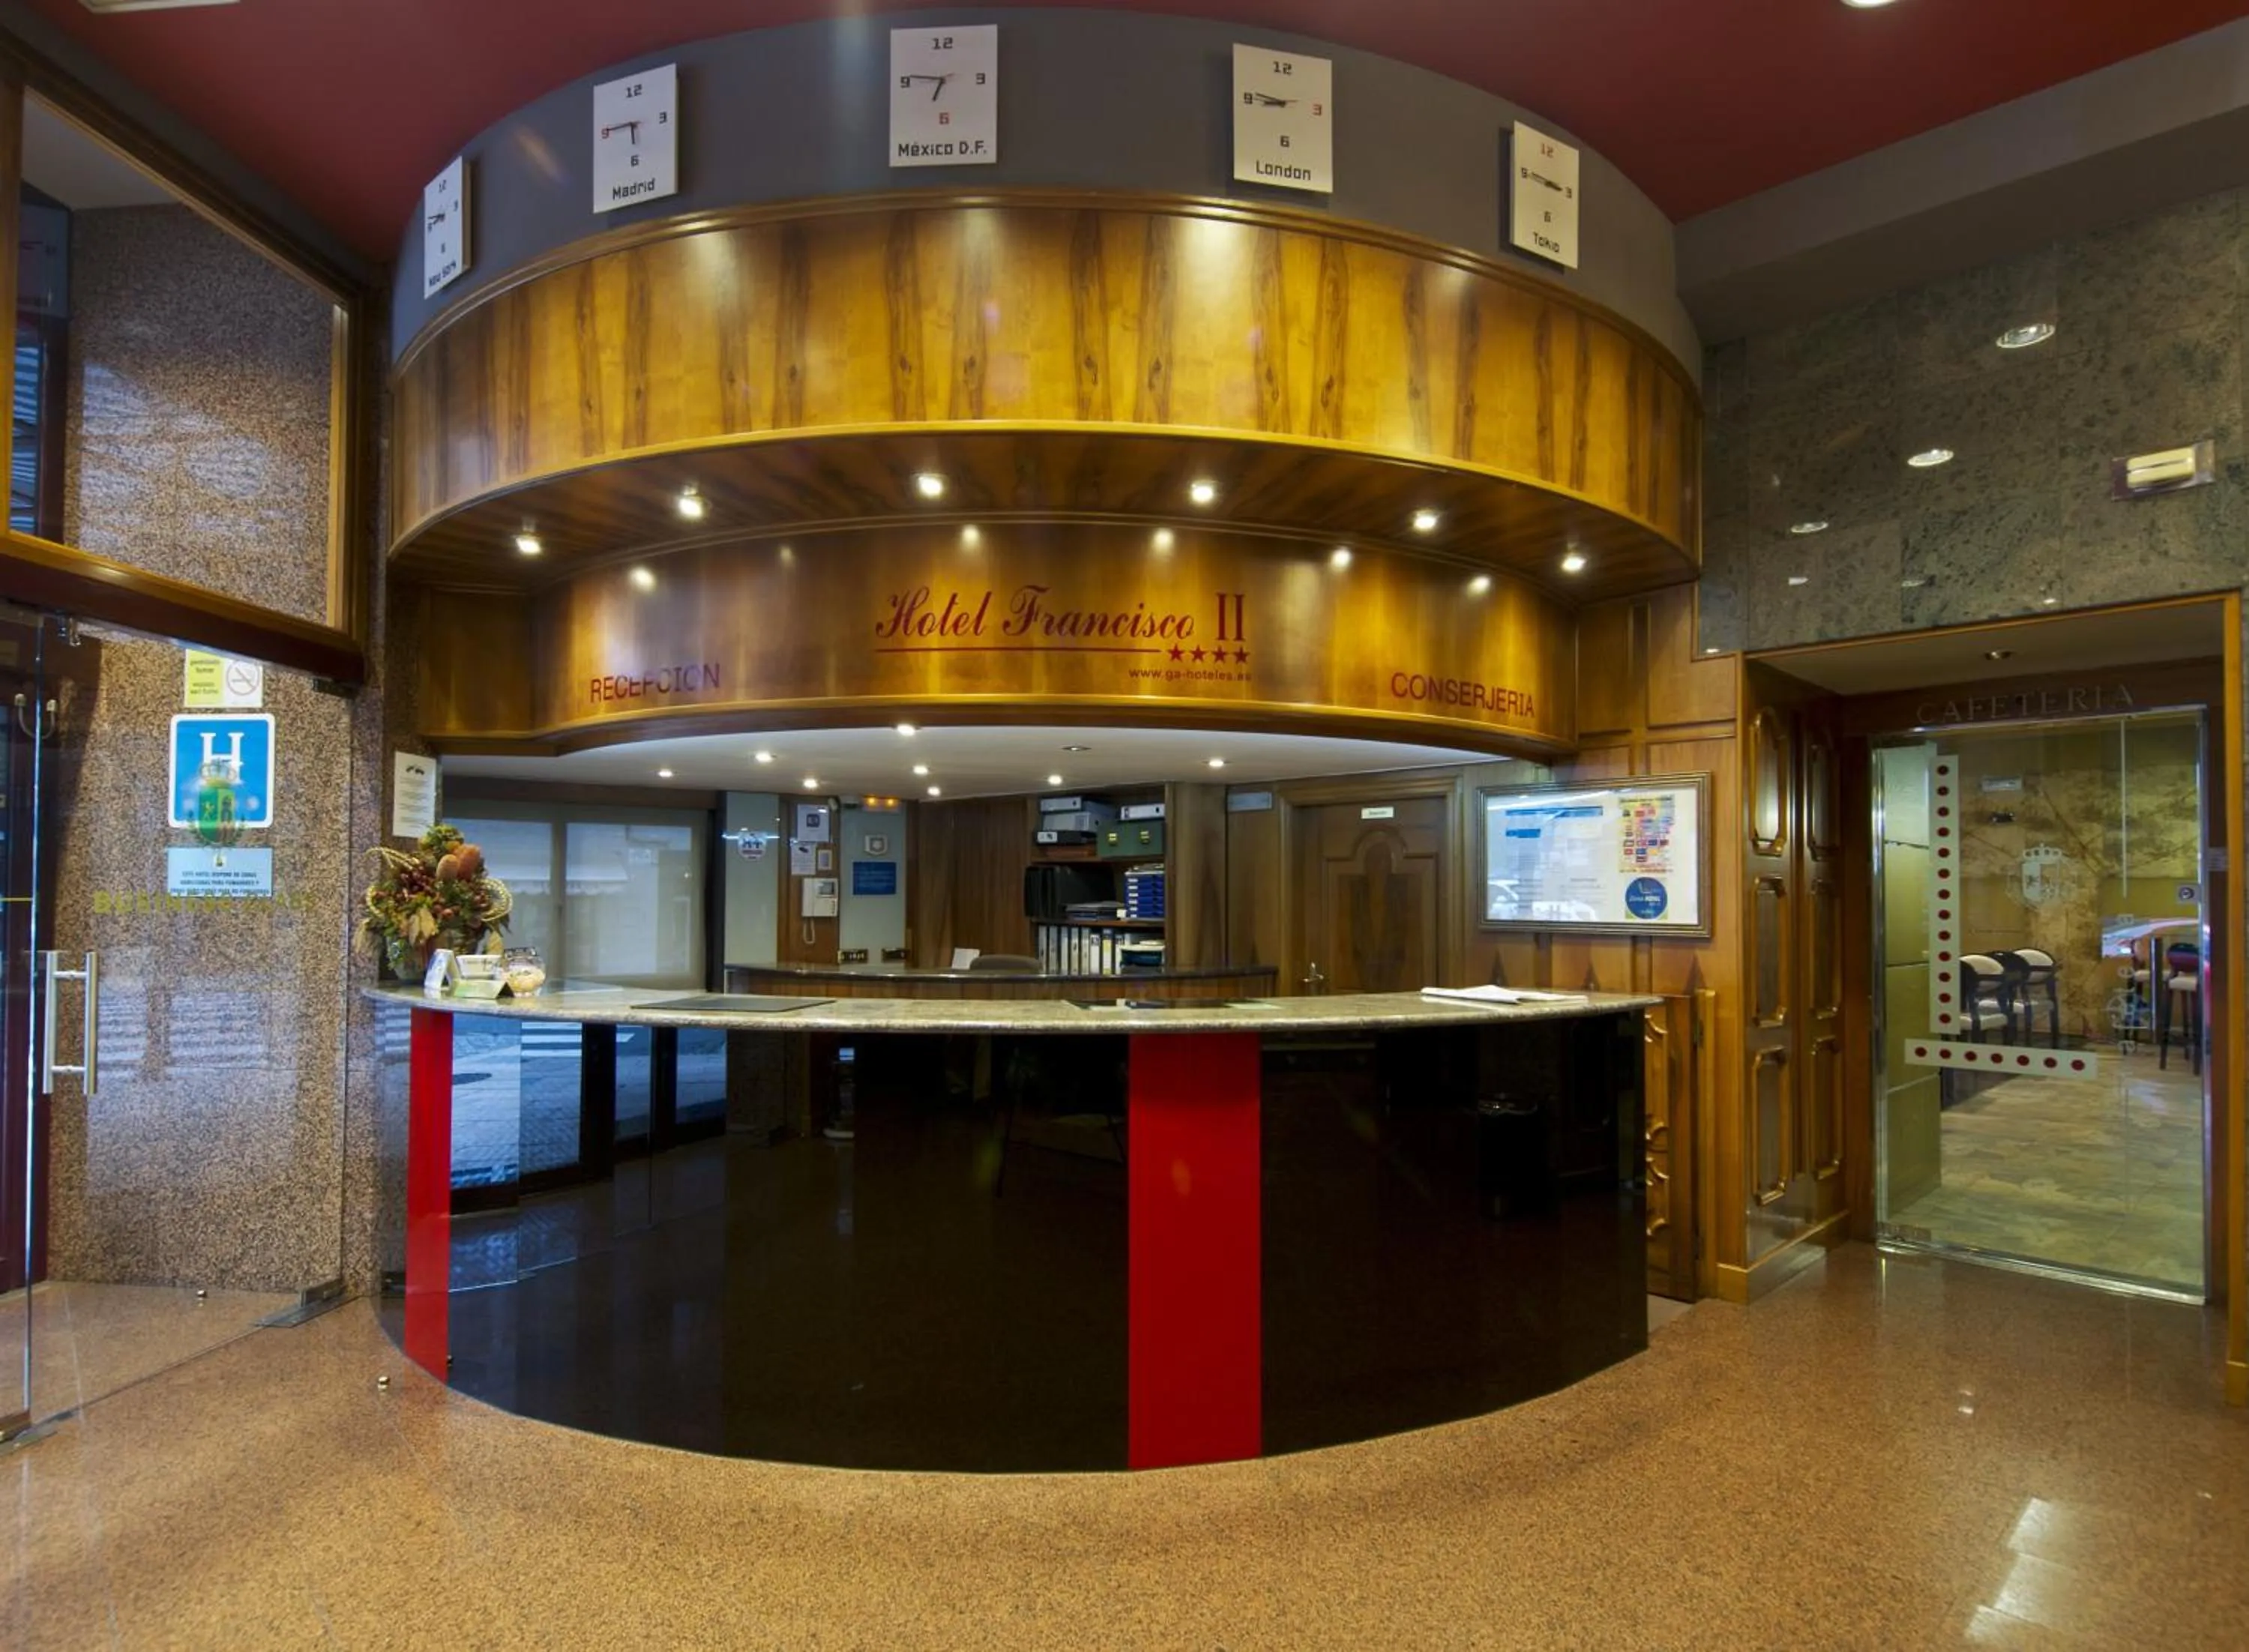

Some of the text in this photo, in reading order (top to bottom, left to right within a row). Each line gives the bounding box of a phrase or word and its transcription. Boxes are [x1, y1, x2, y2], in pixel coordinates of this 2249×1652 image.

[932, 37, 953, 49] 12
[1274, 61, 1292, 75] 12
[900, 76, 911, 88] 9
[976, 73, 985, 85] 3
[626, 84, 642, 98] 12
[1313, 103, 1322, 116] 3
[659, 112, 667, 124] 3
[939, 112, 949, 124] 6
[601, 127, 609, 139] 9
[1280, 136, 1289, 148] 6
[630, 155, 639, 167] 6
[1256, 160, 1311, 181] London
[612, 178, 655, 200] Madrid
[876, 584, 1245, 642] Hotel Francisco II
[1391, 672, 1535, 717] CONSERJERIA
[1917, 684, 2134, 723] CAFETERIA
[199, 732, 244, 785] H
